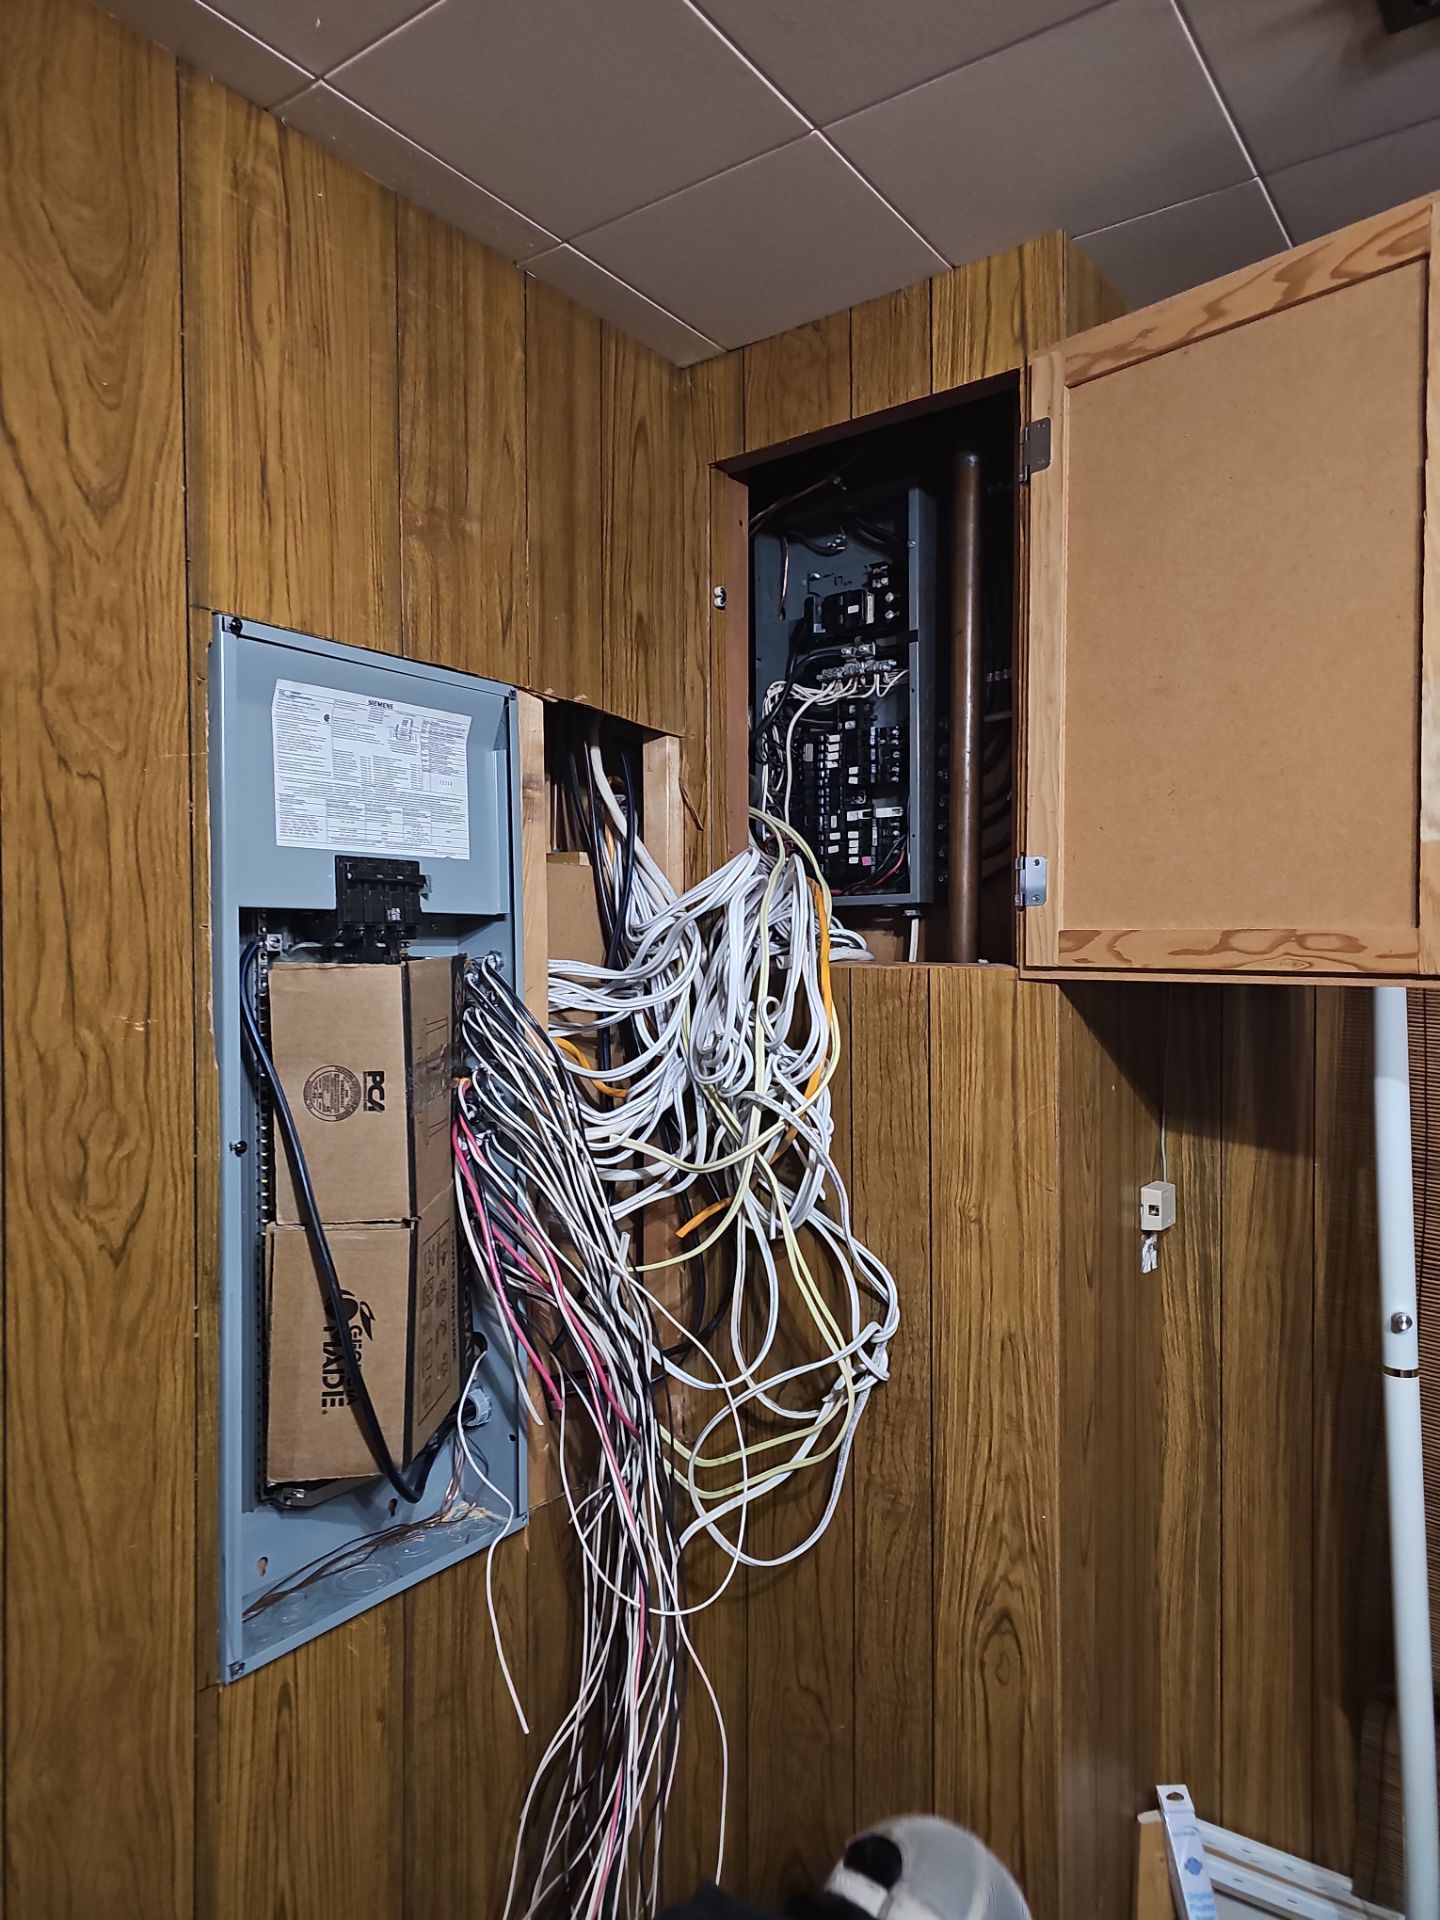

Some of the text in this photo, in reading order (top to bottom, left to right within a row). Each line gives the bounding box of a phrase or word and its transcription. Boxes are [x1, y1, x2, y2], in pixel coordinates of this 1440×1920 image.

[368, 699, 394, 710] SIEMENS
[367, 1070, 385, 1112] PCA
[322, 1326, 346, 1408] MADE
